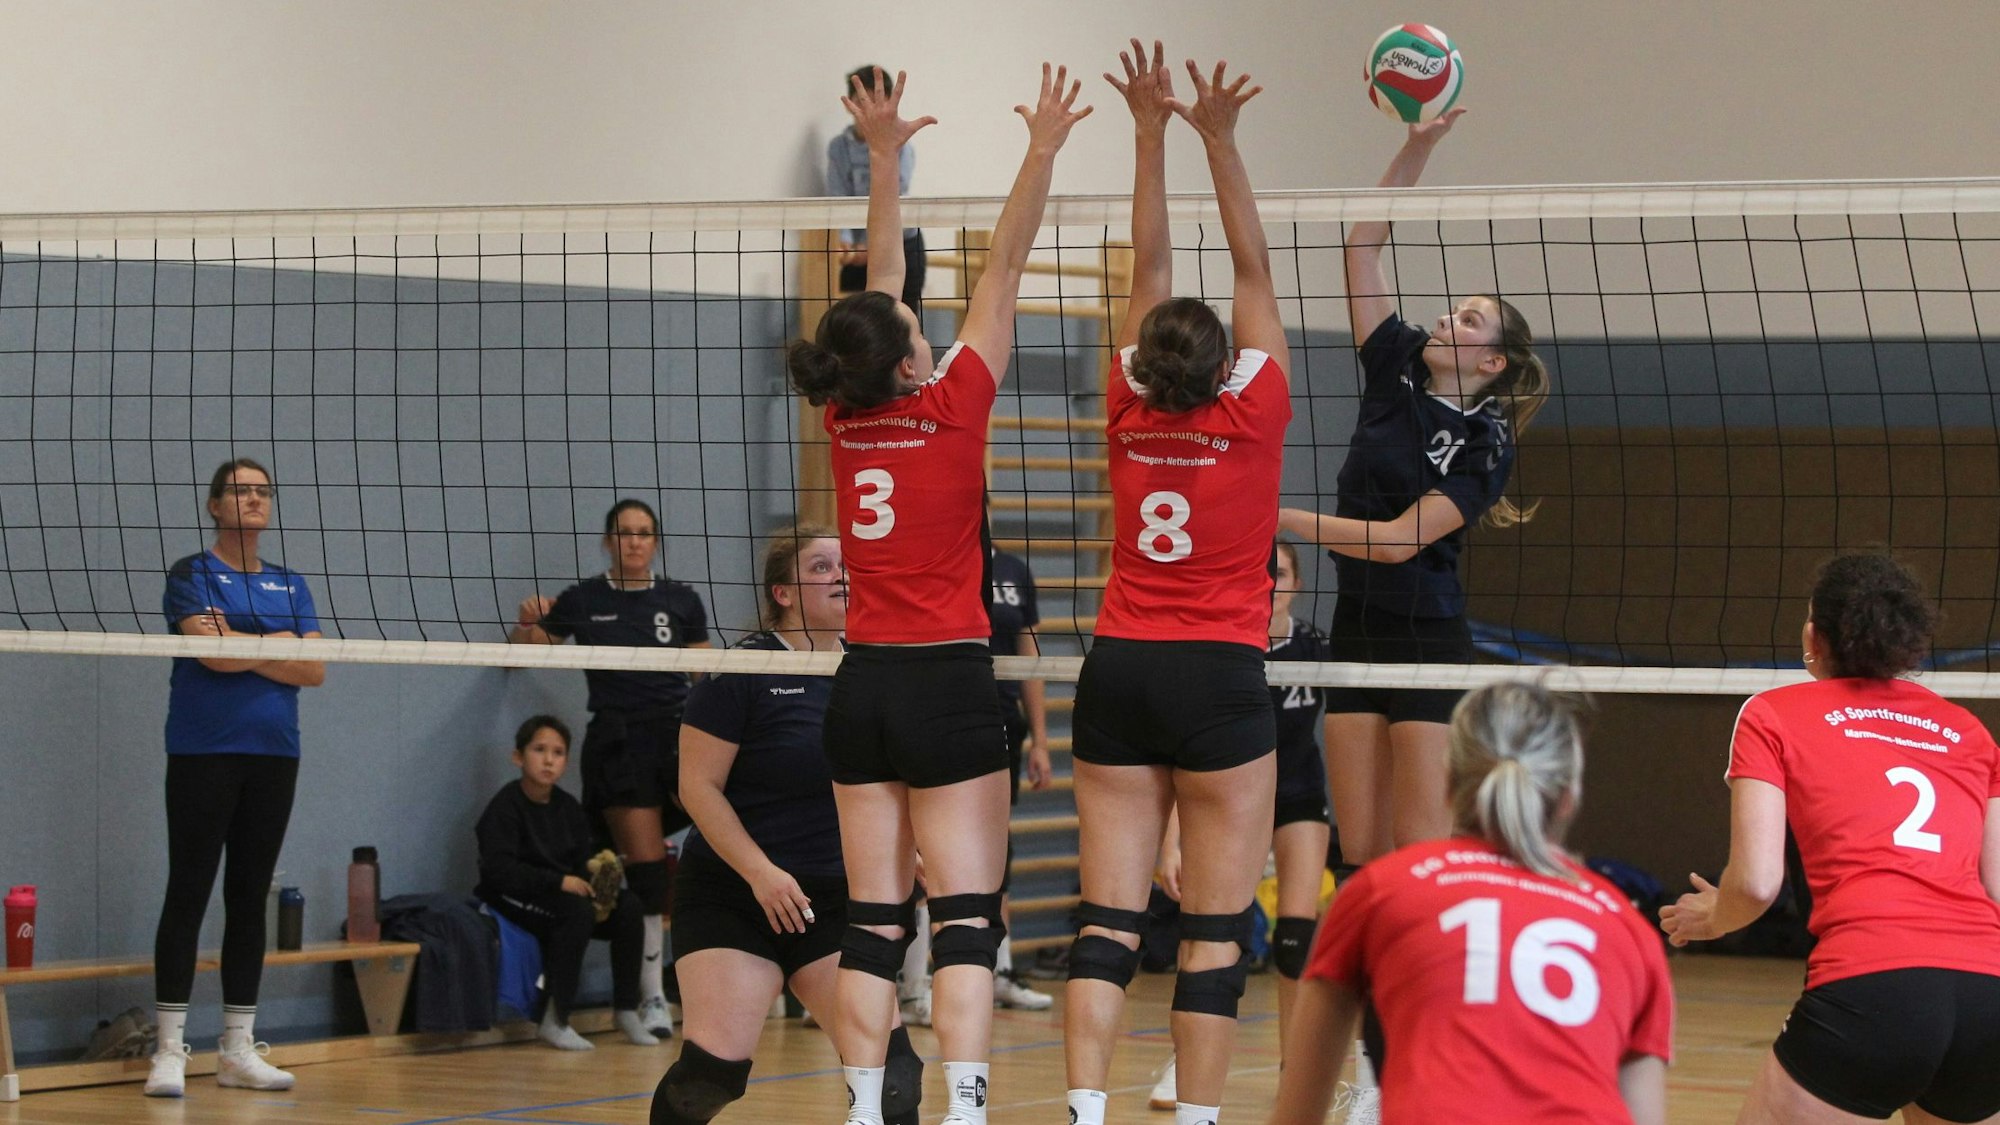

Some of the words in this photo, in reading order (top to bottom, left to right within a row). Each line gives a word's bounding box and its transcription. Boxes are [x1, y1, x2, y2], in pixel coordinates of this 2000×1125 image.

[1391, 50, 1430, 75] molten
[920, 419, 937, 434] 69
[840, 438, 925, 451] Marmagen-Nettersheim
[1127, 449, 1216, 467] Marmagen-Nettersheim
[1211, 436, 1230, 452] 69
[1425, 429, 1465, 476] 21
[851, 469, 896, 540] 3
[1137, 491, 1192, 562] 8
[993, 580, 1020, 606] 18
[653, 611, 672, 644] 8
[779, 687, 805, 695] hummel
[1824, 709, 1847, 726] SG
[1845, 706, 1940, 733] Sportfreunde
[1942, 727, 1962, 744] 69
[1885, 766, 1941, 853] 2
[1438, 897, 1602, 1028] 16
